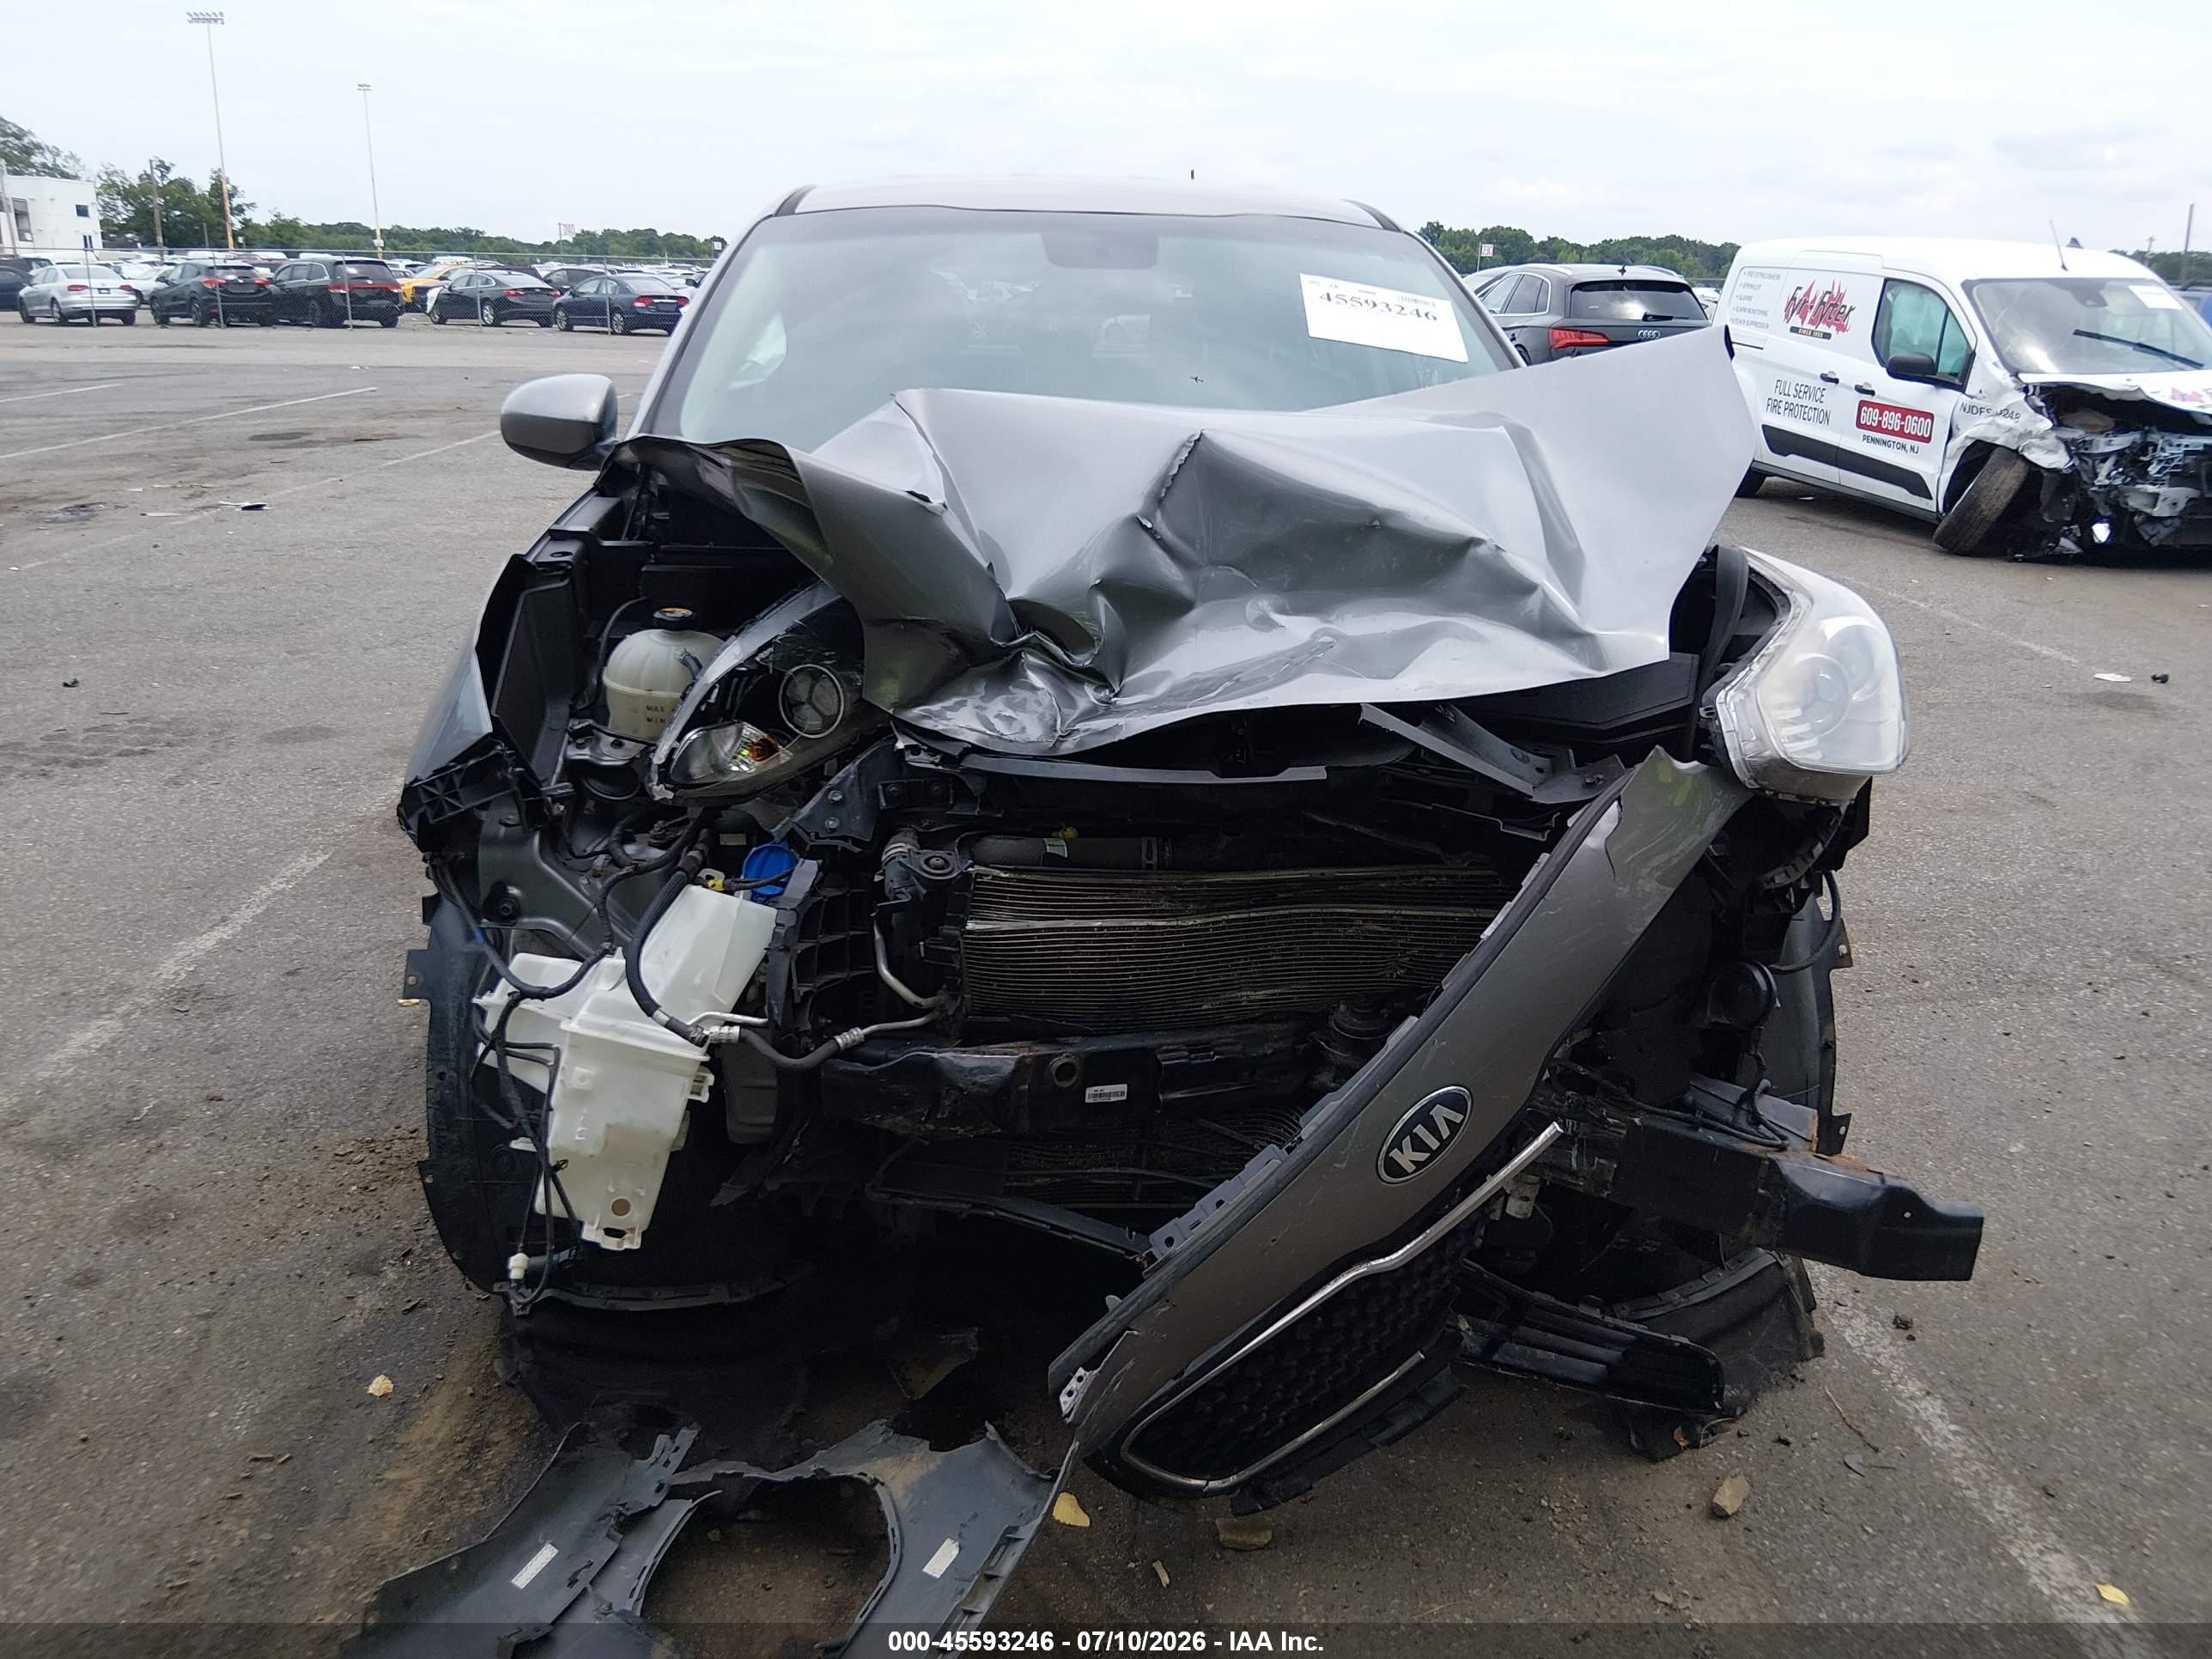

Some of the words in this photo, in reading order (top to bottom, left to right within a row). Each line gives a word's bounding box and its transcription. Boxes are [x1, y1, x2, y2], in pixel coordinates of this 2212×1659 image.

[1319, 292, 1438, 322] 45593246
[1774, 379, 1791, 397] FULL
[1792, 383, 1826, 404] SERVICE
[1765, 398, 1783, 415] FIRE
[1784, 401, 1831, 426] PROTECTION
[1860, 406, 1932, 438] 609-896-0600
[1862, 434, 1908, 453] PENNINGTON,
[1909, 446, 1920, 454] NJ
[1389, 1104, 1464, 1174] KIA
